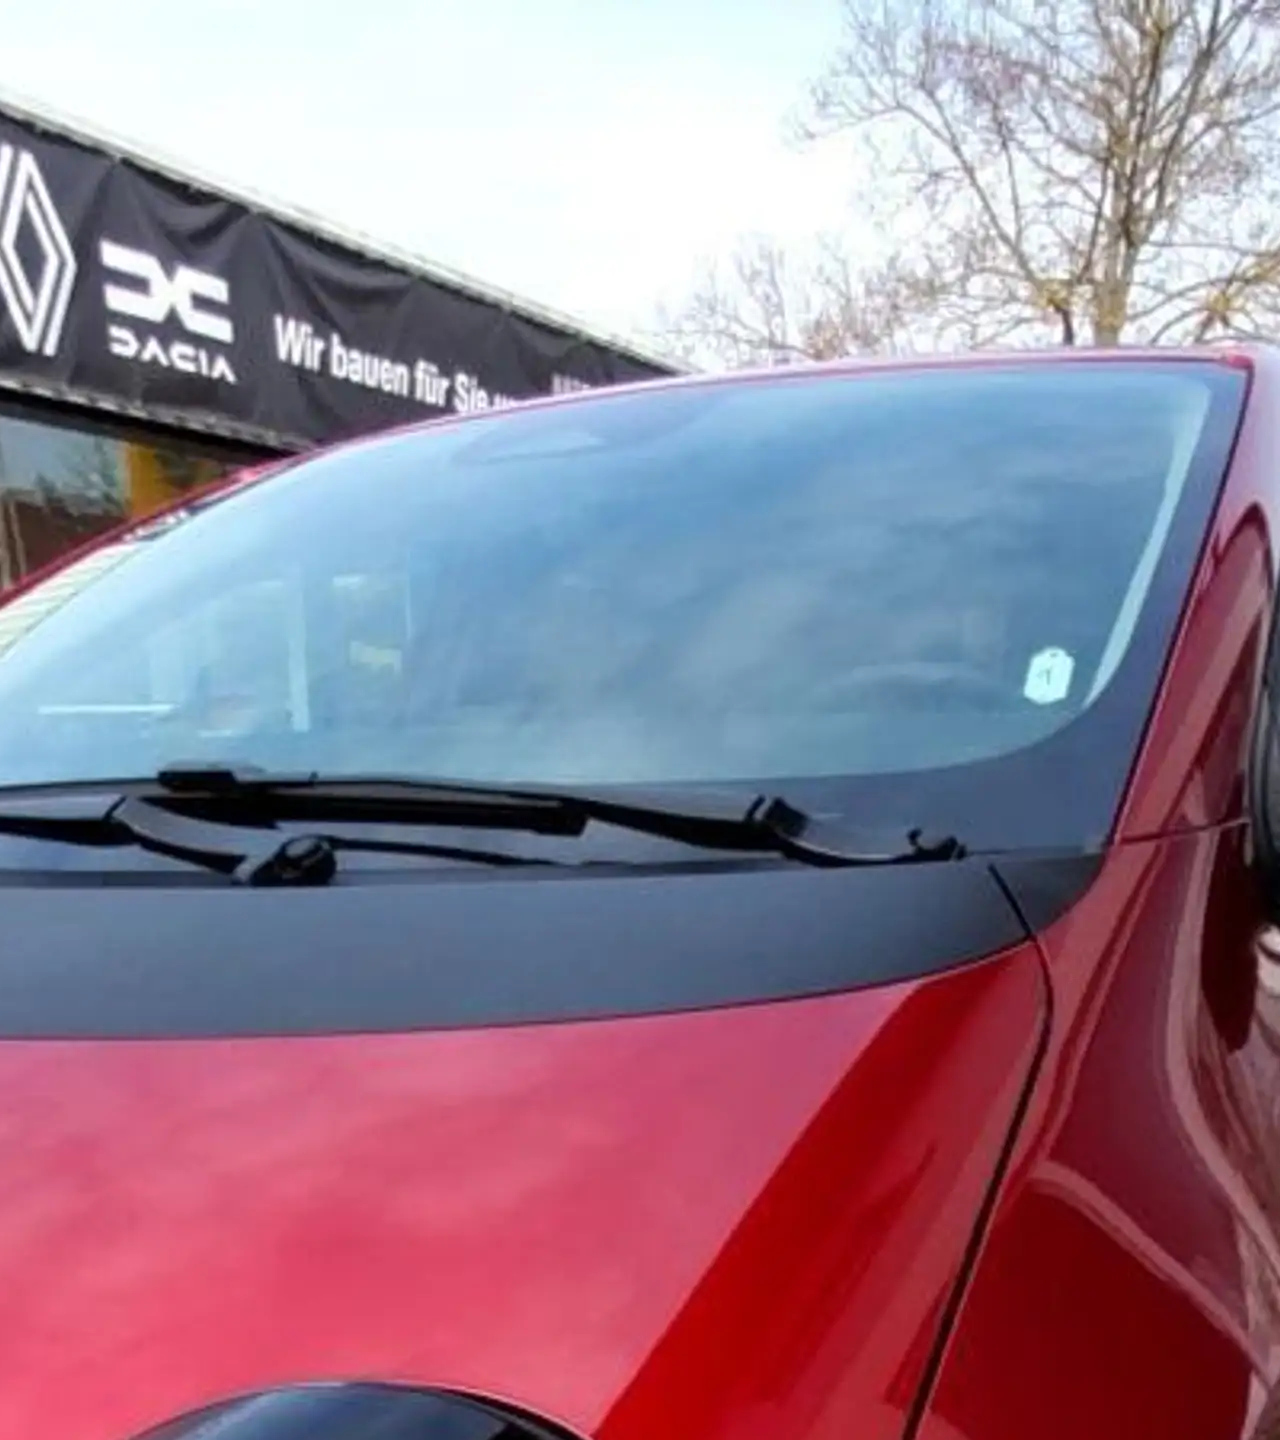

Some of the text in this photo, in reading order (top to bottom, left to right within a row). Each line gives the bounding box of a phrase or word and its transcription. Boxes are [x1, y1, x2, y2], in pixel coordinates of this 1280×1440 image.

[108, 324, 238, 385] DACIA
[274, 313, 325, 372] Wir
[329, 332, 408, 397] bauen
[414, 358, 450, 409] für
[454, 370, 488, 412] Sie
